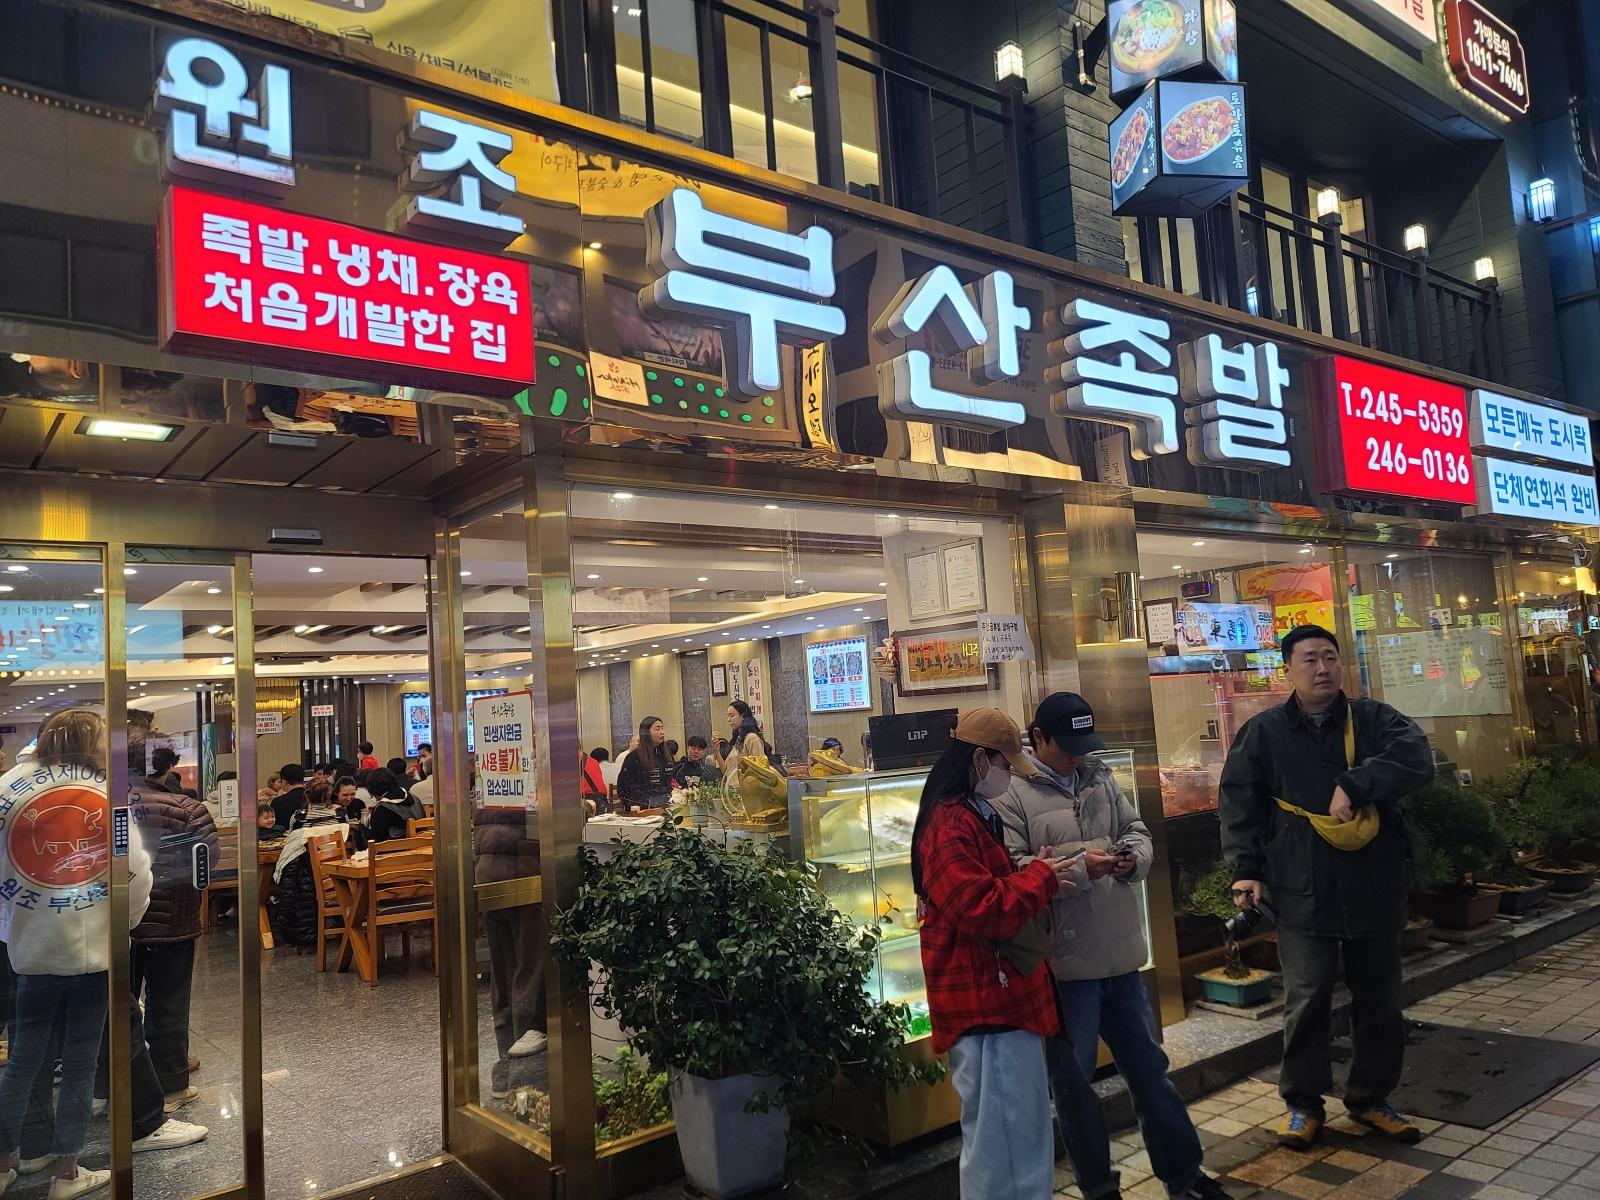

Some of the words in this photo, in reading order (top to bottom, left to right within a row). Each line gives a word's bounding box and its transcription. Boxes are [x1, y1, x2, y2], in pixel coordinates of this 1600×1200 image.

[1473, 18, 1511, 62] 가맹문의
[1466, 38, 1524, 97] 1811-7496
[204, 272, 454, 355] 처음개발한
[470, 319, 507, 363] 집
[655, 188, 1292, 468] 부산족발
[1340, 381, 1464, 439] T.245-5359
[1486, 403, 1546, 446] 모든메뉴
[1548, 414, 1588, 454] 도시락
[1366, 437, 1470, 486] 246-0136
[1493, 470, 1568, 511] 단체연회석
[1570, 482, 1598, 517] 완비
[483, 723, 522, 743] 민생지원금
[486, 778, 524, 797] 업소입니다
